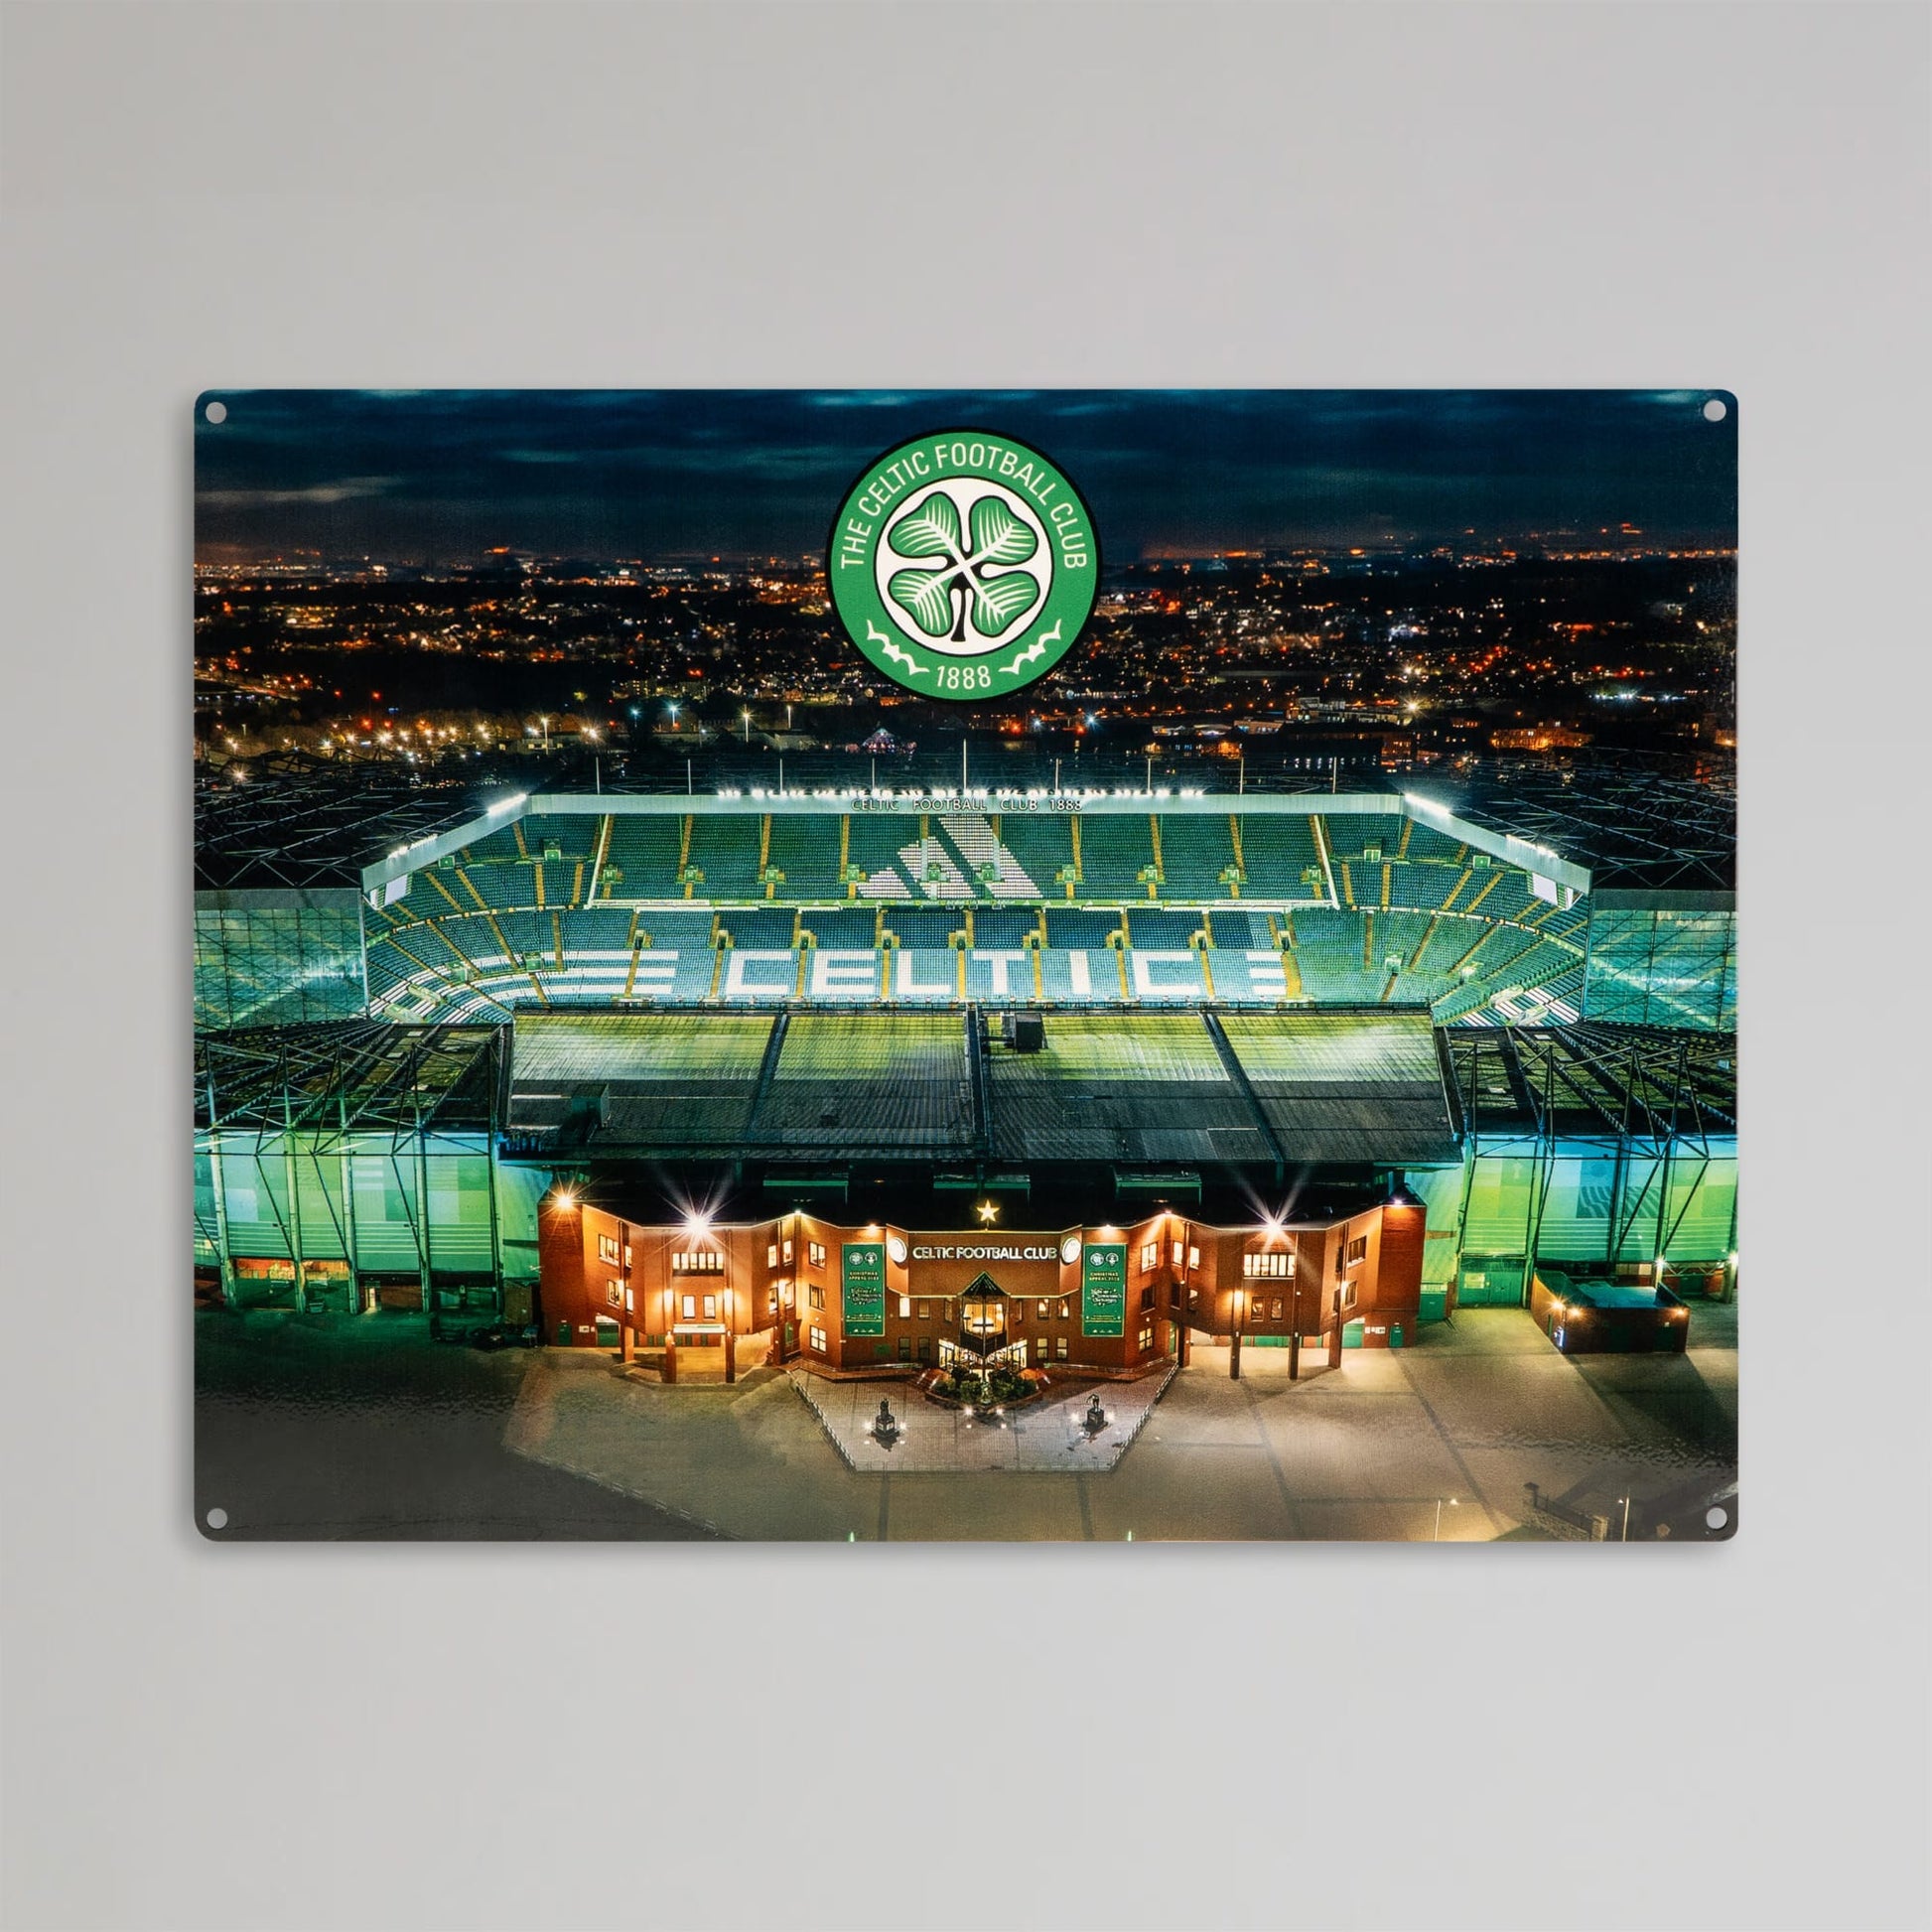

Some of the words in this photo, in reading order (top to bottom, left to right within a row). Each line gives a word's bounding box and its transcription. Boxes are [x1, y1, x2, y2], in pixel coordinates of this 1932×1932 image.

[841, 518, 872, 569] THE
[858, 451, 930, 516] CELTIC
[935, 443, 1057, 506] FOOTBALL
[1049, 502, 1087, 569] CLUB
[936, 665, 992, 690] 1888
[852, 797, 898, 812] CELTIC
[911, 797, 988, 812] FOOTBALL
[1000, 797, 1038, 812] CLUB
[1048, 797, 1083, 812] 1888
[725, 950, 1200, 995] CELTIC
[912, 1246, 955, 1260] CELTIC
[956, 1246, 1023, 1260] FOOTBALL
[1024, 1246, 1058, 1260] CLUB
